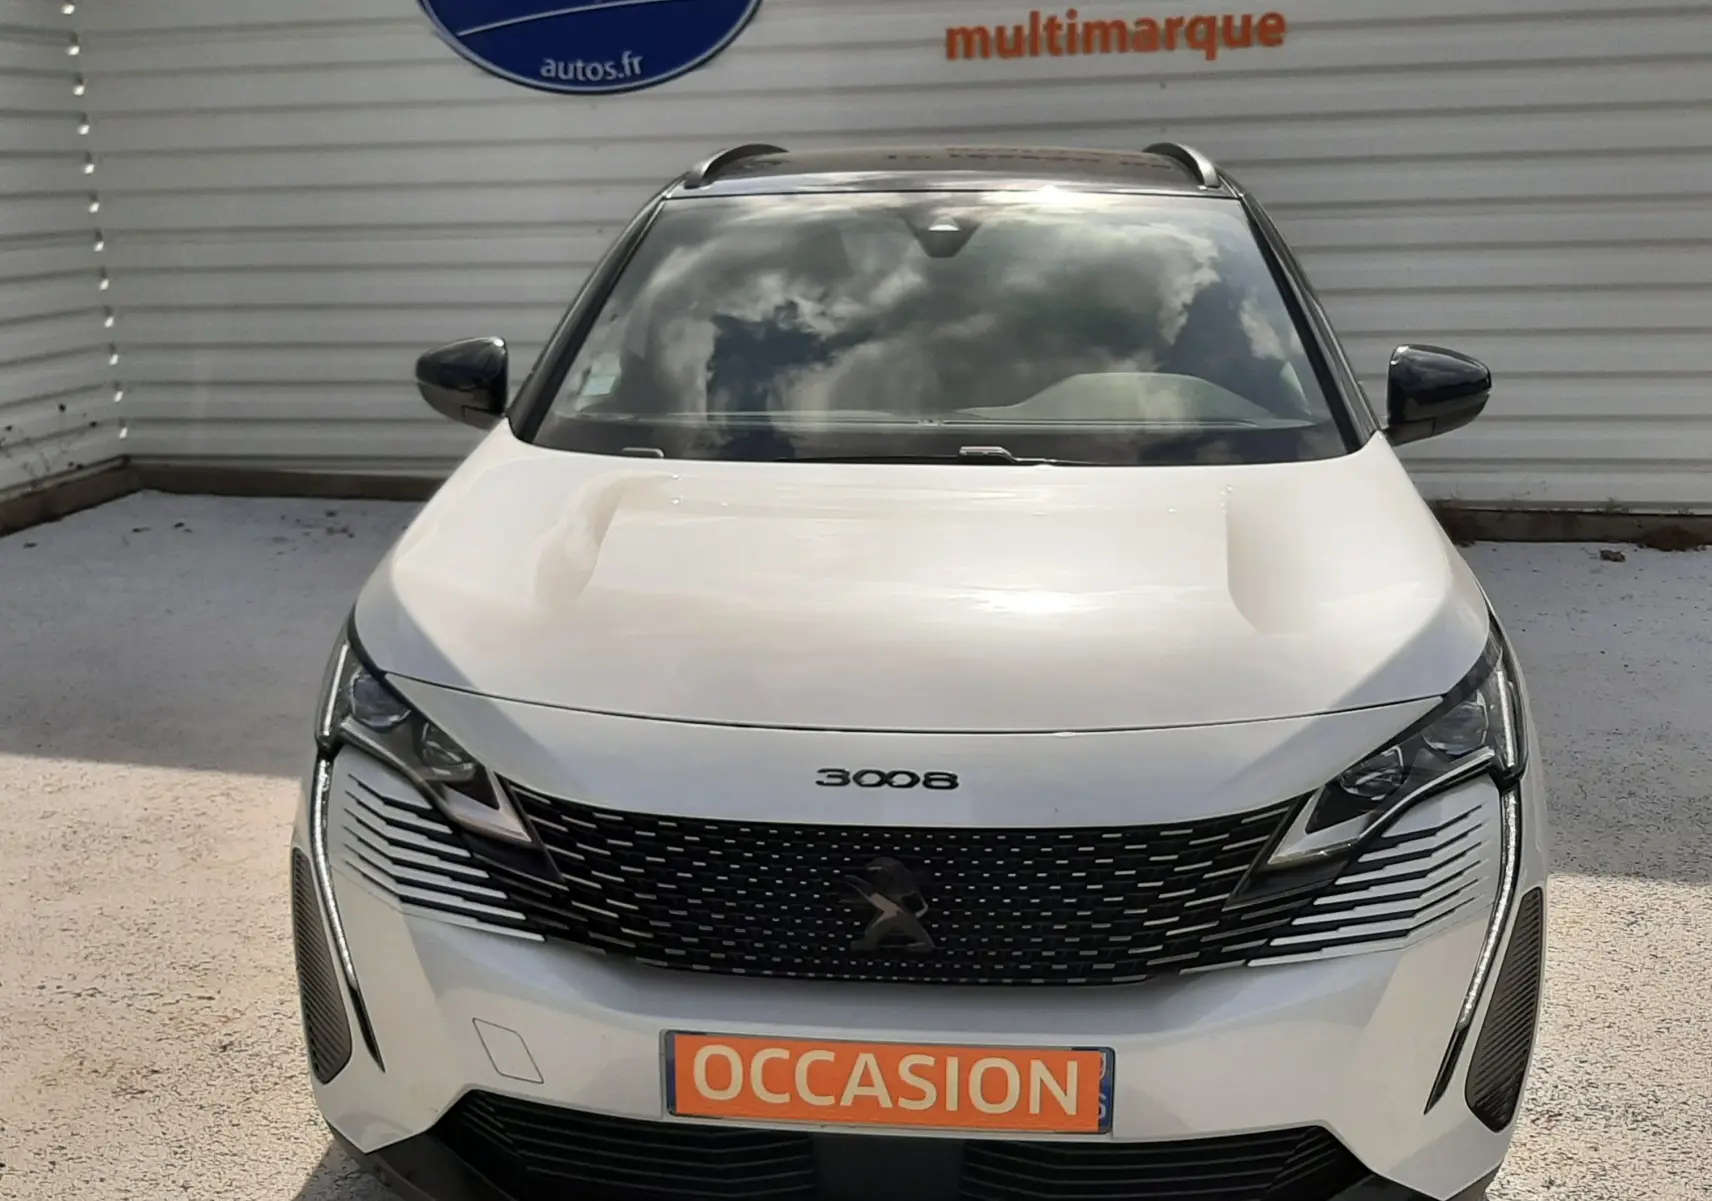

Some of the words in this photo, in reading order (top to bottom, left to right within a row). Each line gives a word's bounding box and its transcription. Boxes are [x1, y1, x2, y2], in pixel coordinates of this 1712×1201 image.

[945, 8, 1286, 61] multimarque
[540, 50, 643, 81] autos.fr
[815, 768, 960, 790] 3008
[693, 1044, 1078, 1115] OCCASION
